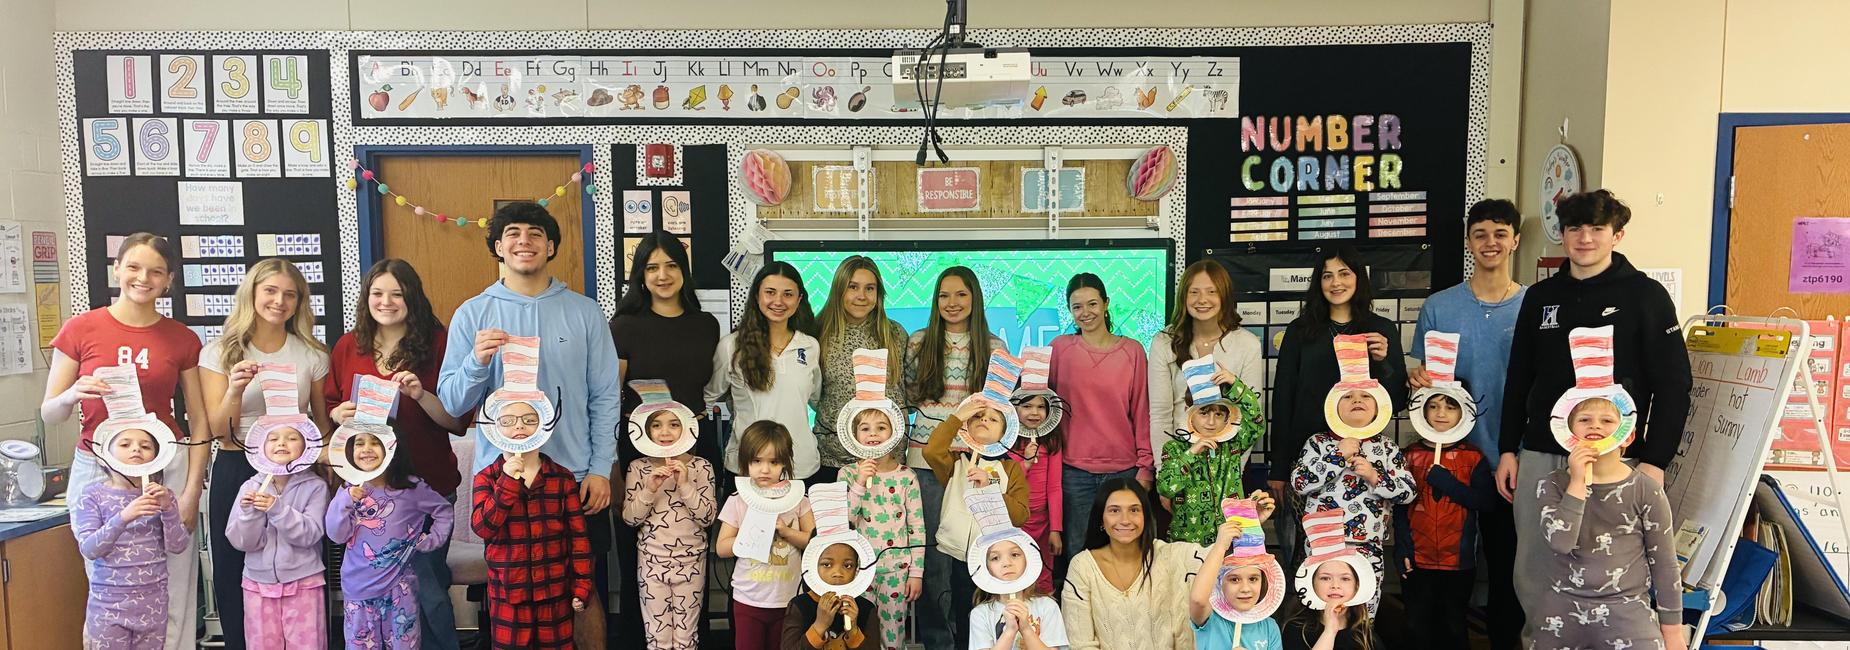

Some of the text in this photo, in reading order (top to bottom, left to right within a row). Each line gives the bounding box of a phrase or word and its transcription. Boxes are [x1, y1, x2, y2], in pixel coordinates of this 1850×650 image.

[123, 56, 302, 100] 1 2 3 4
[463, 61, 482, 76] Dd
[495, 60, 512, 76] Ee
[526, 60, 541, 76] Ff
[552, 60, 575, 83] Gg
[590, 61, 608, 76] Hh
[622, 60, 637, 76] Ii
[653, 61, 667, 83] Jj
[688, 61, 705, 76] Kk
[719, 61, 730, 76] Ll
[743, 61, 769, 76] Mm
[778, 61, 797, 76] Nn
[812, 62, 835, 77] Oo
[851, 61, 867, 84] Pp
[1030, 61, 1047, 77] Uu
[1065, 61, 1083, 76] Vv
[1096, 61, 1123, 77] Ww
[1135, 61, 1154, 77] Xx
[1170, 61, 1190, 84] Yy
[1207, 61, 1223, 76] Zz
[1241, 114, 1402, 153] NUMBER
[91, 119, 322, 163] 5 6 7 8 9
[1241, 153, 1403, 192] CORNER
[185, 182, 235, 194] How many
[944, 177, 954, 187] BE
[925, 190, 973, 200] RESPONSIBLE
[1376, 192, 1420, 202] September
[1377, 216, 1418, 225] November
[1314, 230, 1341, 240] August
[34, 246, 57, 260] GRIP
[1290, 274, 1313, 283] Marc
[1802, 275, 1843, 285] ztp6190
[117, 346, 149, 370] 84
[1736, 359, 1769, 385] Lamb
[1728, 386, 1749, 412] hot
[1714, 414, 1745, 451] Sunny
[1824, 541, 1840, 554] 16
